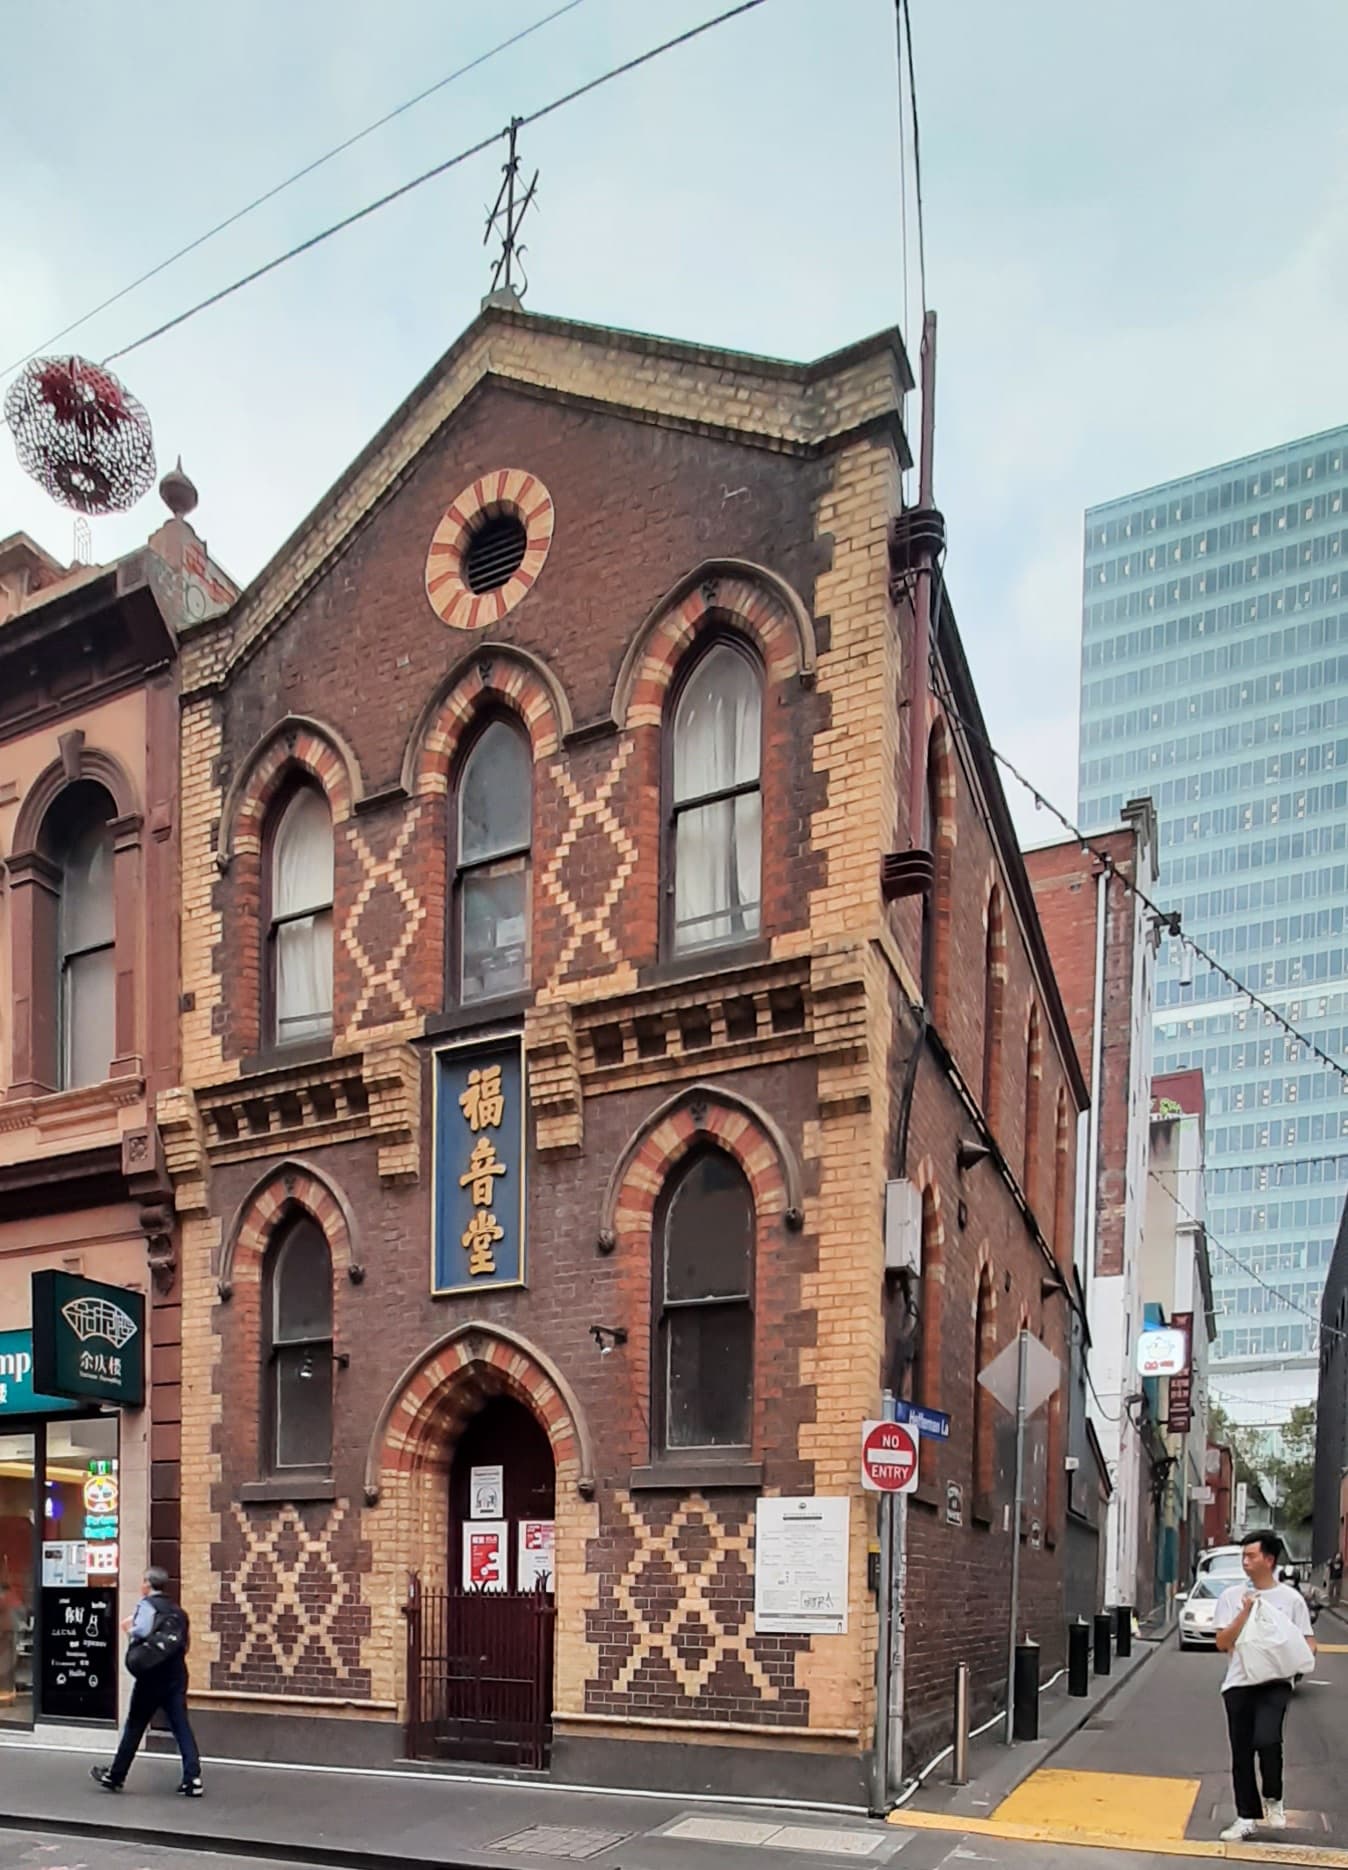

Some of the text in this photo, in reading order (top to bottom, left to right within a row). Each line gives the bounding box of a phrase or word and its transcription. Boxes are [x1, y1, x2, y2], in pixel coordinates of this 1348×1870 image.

[459, 1064, 506, 1276] 福音堂
[882, 1435, 900, 1448] NO
[871, 1464, 909, 1480] ENTRY
